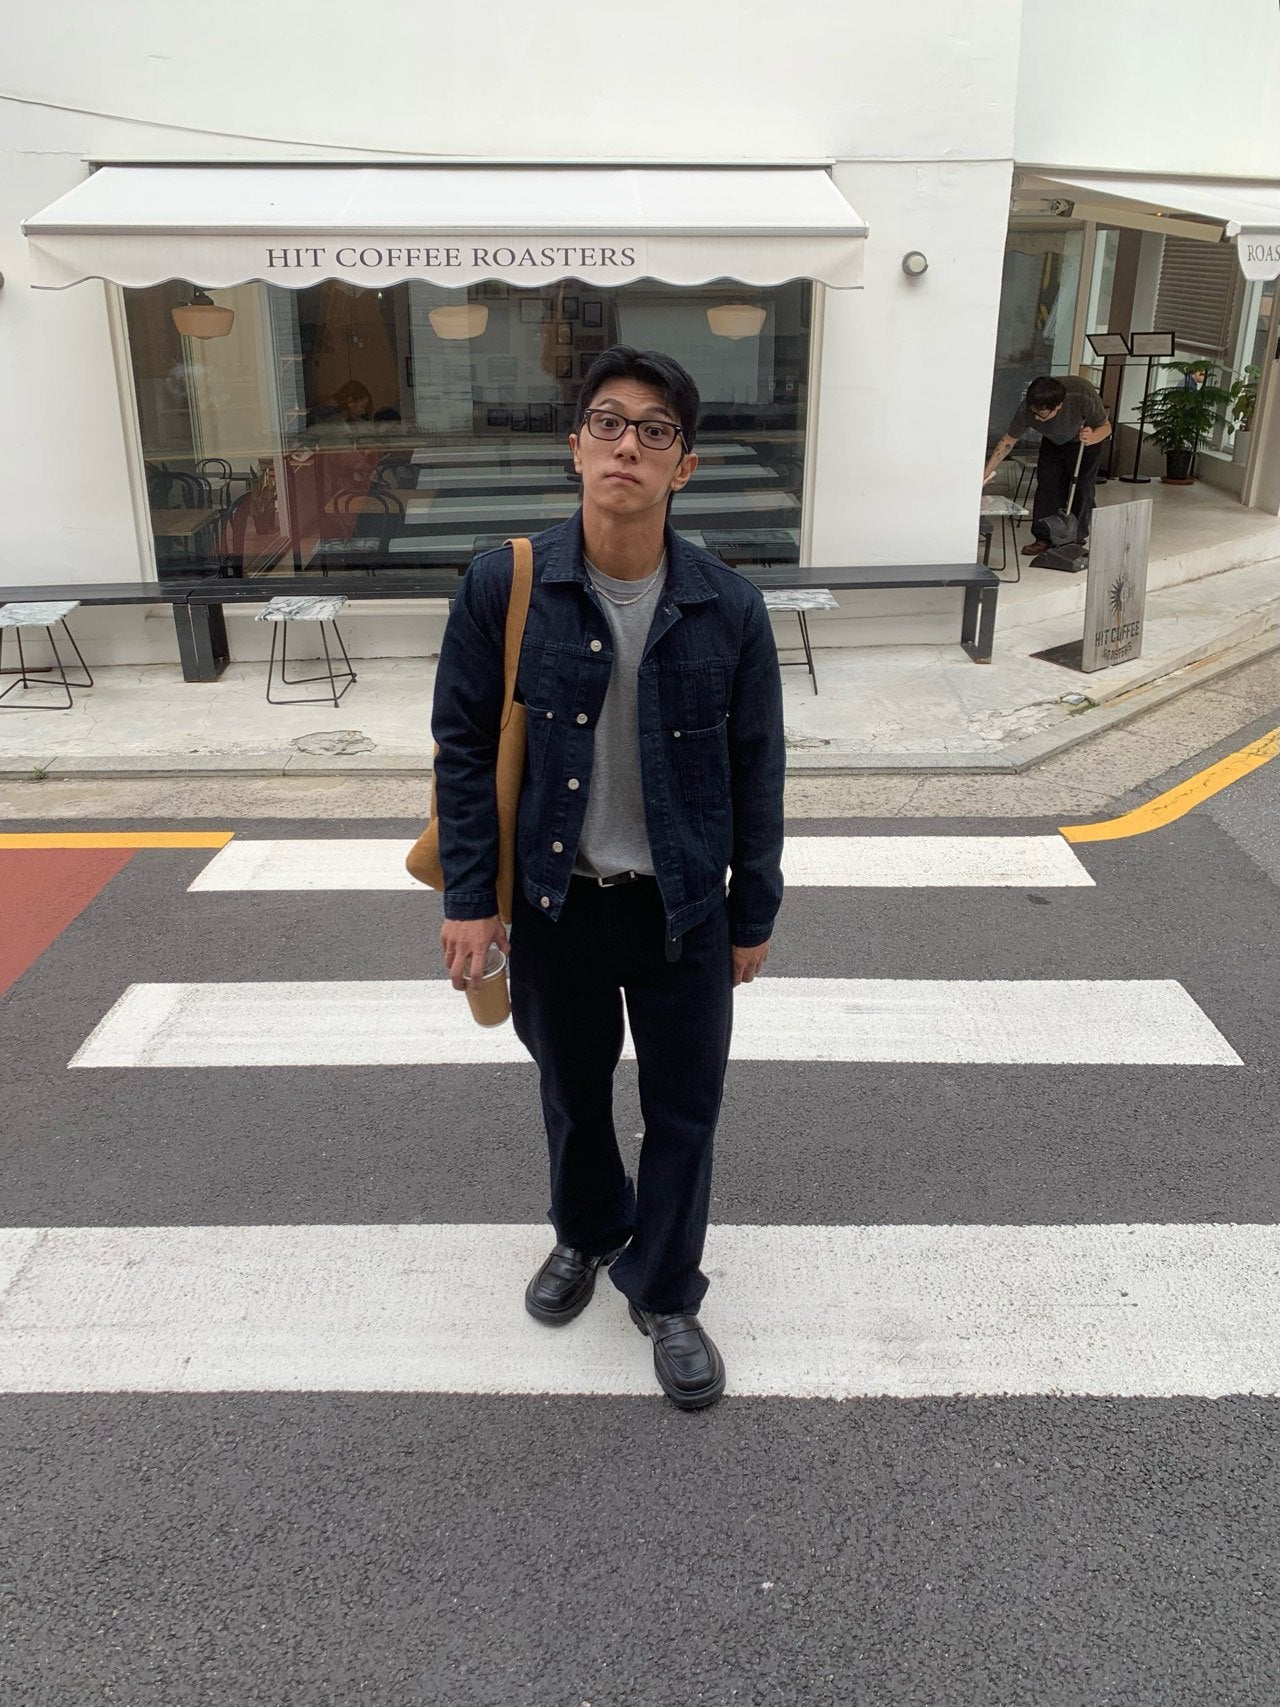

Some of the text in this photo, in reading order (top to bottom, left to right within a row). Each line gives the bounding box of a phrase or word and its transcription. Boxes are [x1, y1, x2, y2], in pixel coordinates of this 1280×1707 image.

[266, 247, 636, 268] HIT COFFEE ROASTERS
[1095, 629, 1110, 647] HIT
